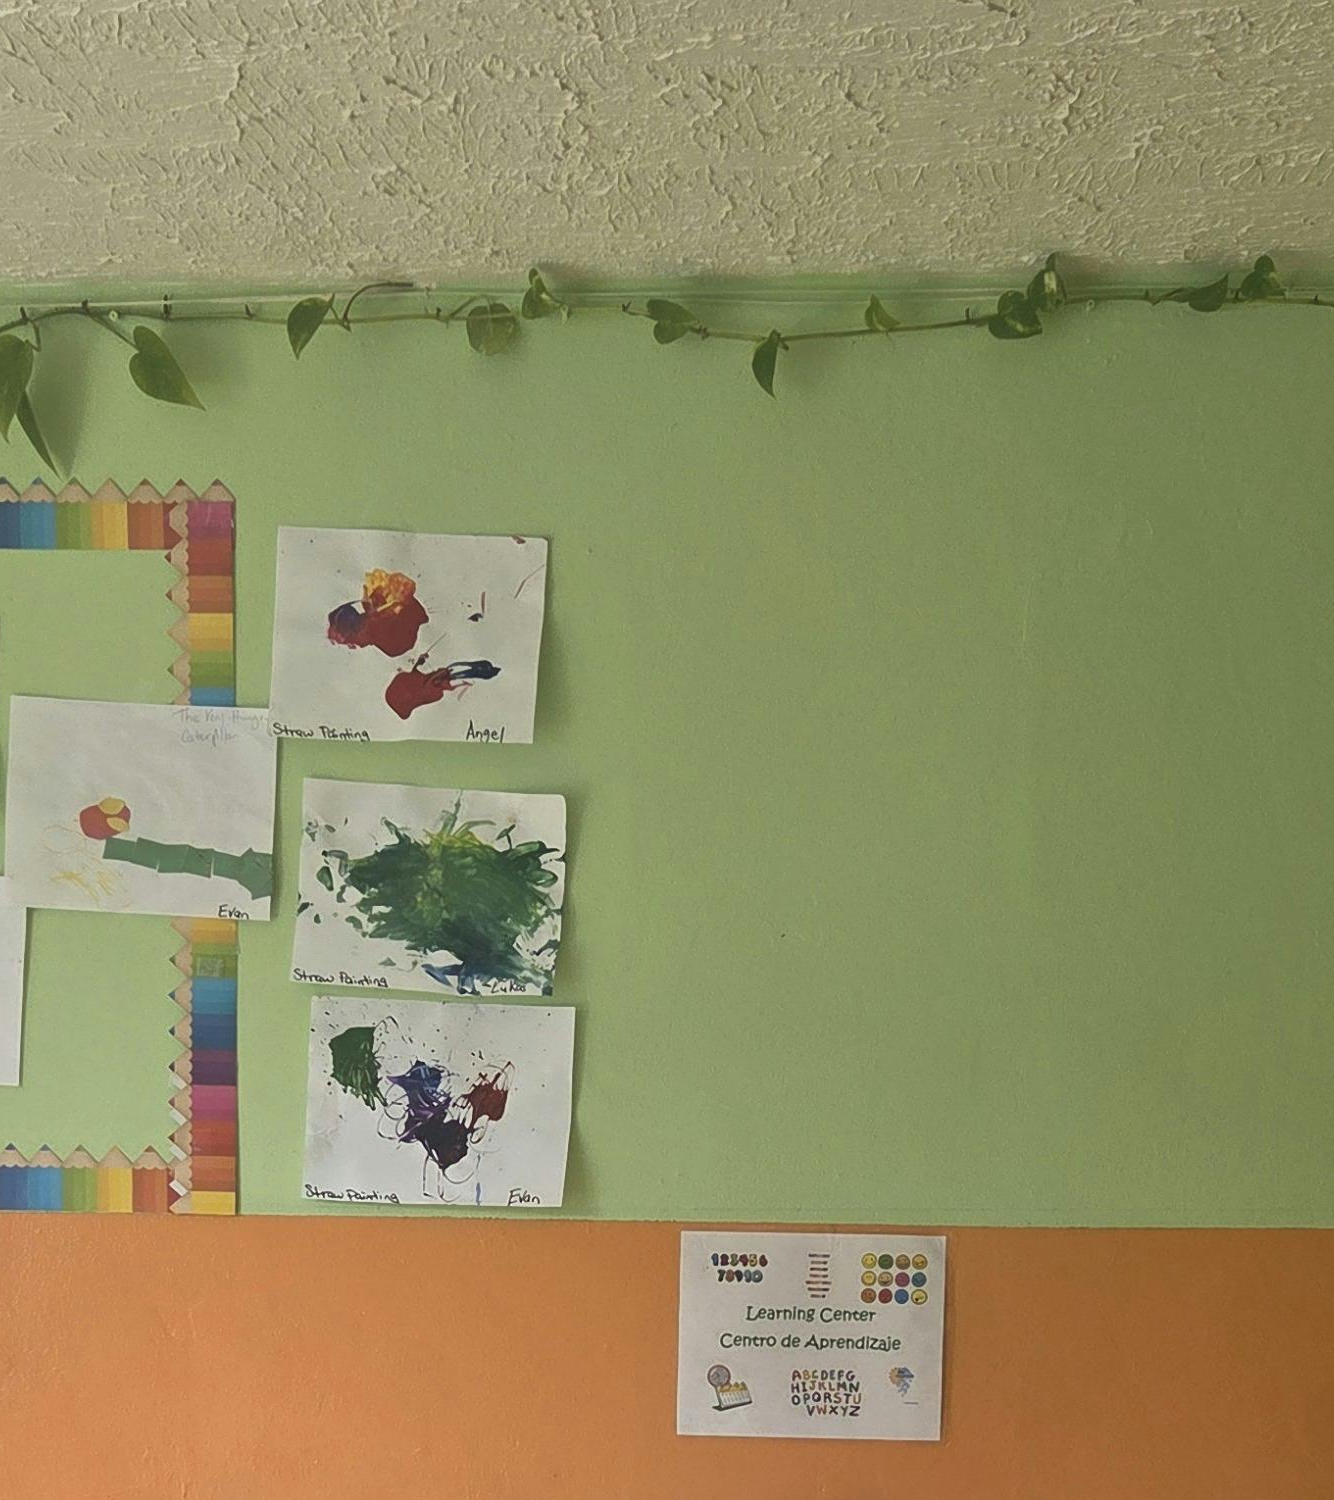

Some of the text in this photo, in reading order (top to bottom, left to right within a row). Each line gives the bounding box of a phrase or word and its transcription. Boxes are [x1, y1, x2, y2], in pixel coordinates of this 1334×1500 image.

[273, 723, 370, 741] Straw Painting
[467, 724, 505, 742] Angel
[218, 905, 250, 920] Evan
[294, 968, 389, 988] Straw Painting
[305, 1184, 400, 1204] Straw Painting
[508, 1188, 541, 1205] Evan
[746, 1306, 876, 1322] Learning Center
[720, 1333, 901, 1351] Centro de Aprendizaje
